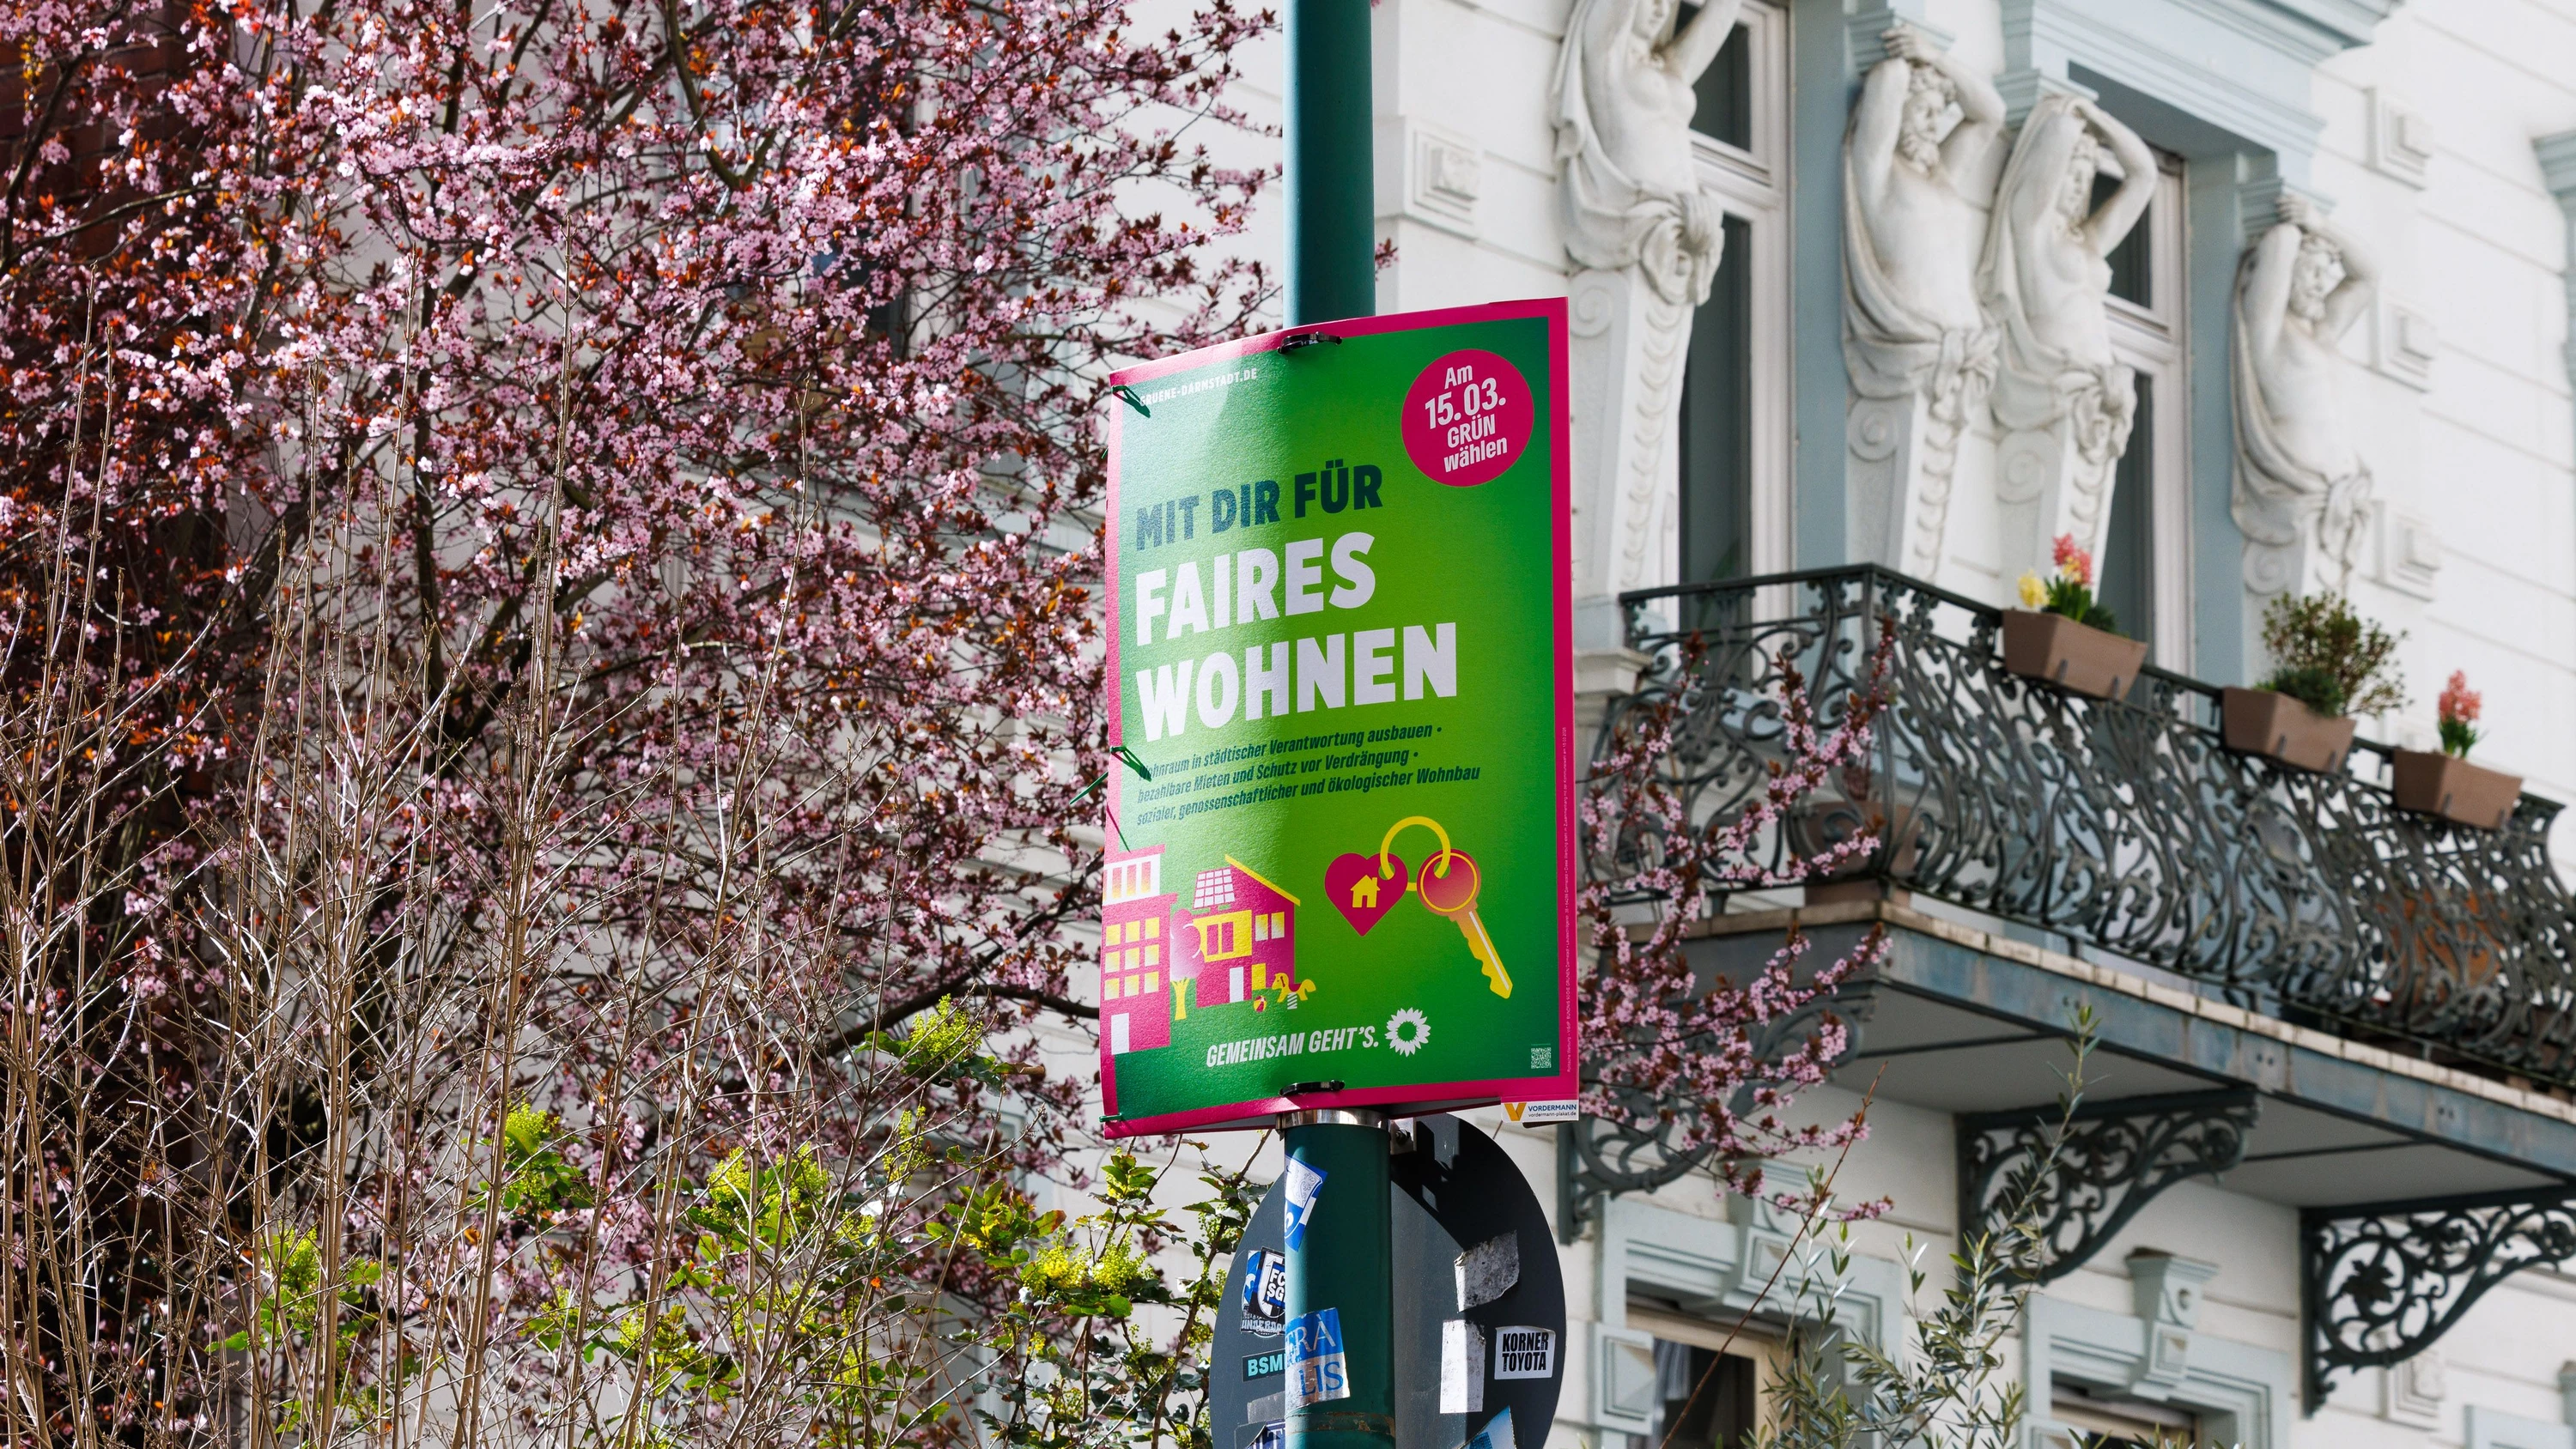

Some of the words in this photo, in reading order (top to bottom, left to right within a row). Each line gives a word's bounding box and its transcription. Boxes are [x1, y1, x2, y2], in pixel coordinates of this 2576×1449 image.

[1140, 368, 1257, 406] GRUENE-DARMSTADT.DE
[1444, 365, 1473, 390] Am
[1425, 378, 1506, 429] 15.03.
[1447, 414, 1496, 448] GRÜN
[1443, 437, 1507, 472] wählen
[1136, 495, 1199, 551] MIT
[1212, 480, 1280, 534] DIR
[1294, 458, 1382, 518] FÜR
[1136, 531, 1376, 646] FAIRES
[1136, 622, 1457, 743] WOHNEN
[1192, 754, 1201, 769] in
[1203, 744, 1266, 767] städtischer
[1269, 731, 1364, 755] Verantwortung
[1368, 724, 1432, 743] ausbauen
[1137, 806, 1176, 825] sozialer,
[1179, 784, 1298, 820] genossenschaftlicher
[1301, 779, 1325, 797] und
[1327, 771, 1413, 793] ökologischer
[1417, 766, 1480, 785] Wohnbau
[1138, 781, 1191, 803] bezahlbare
[1194, 772, 1230, 791] Mieten
[1233, 767, 1254, 784] und
[1257, 761, 1297, 779] Schutz
[1301, 759, 1322, 773] vor
[1326, 749, 1409, 770] Verdrängung
[1206, 1032, 1305, 1068] GEMEINSAM
[1309, 1026, 1379, 1053] GEHT’S.
[1267, 1282, 1285, 1302] SG
[1502, 1352, 1546, 1372] TOYOTA
[1503, 1332, 1549, 1352] KORNER
[1248, 1354, 1285, 1377] BSM
